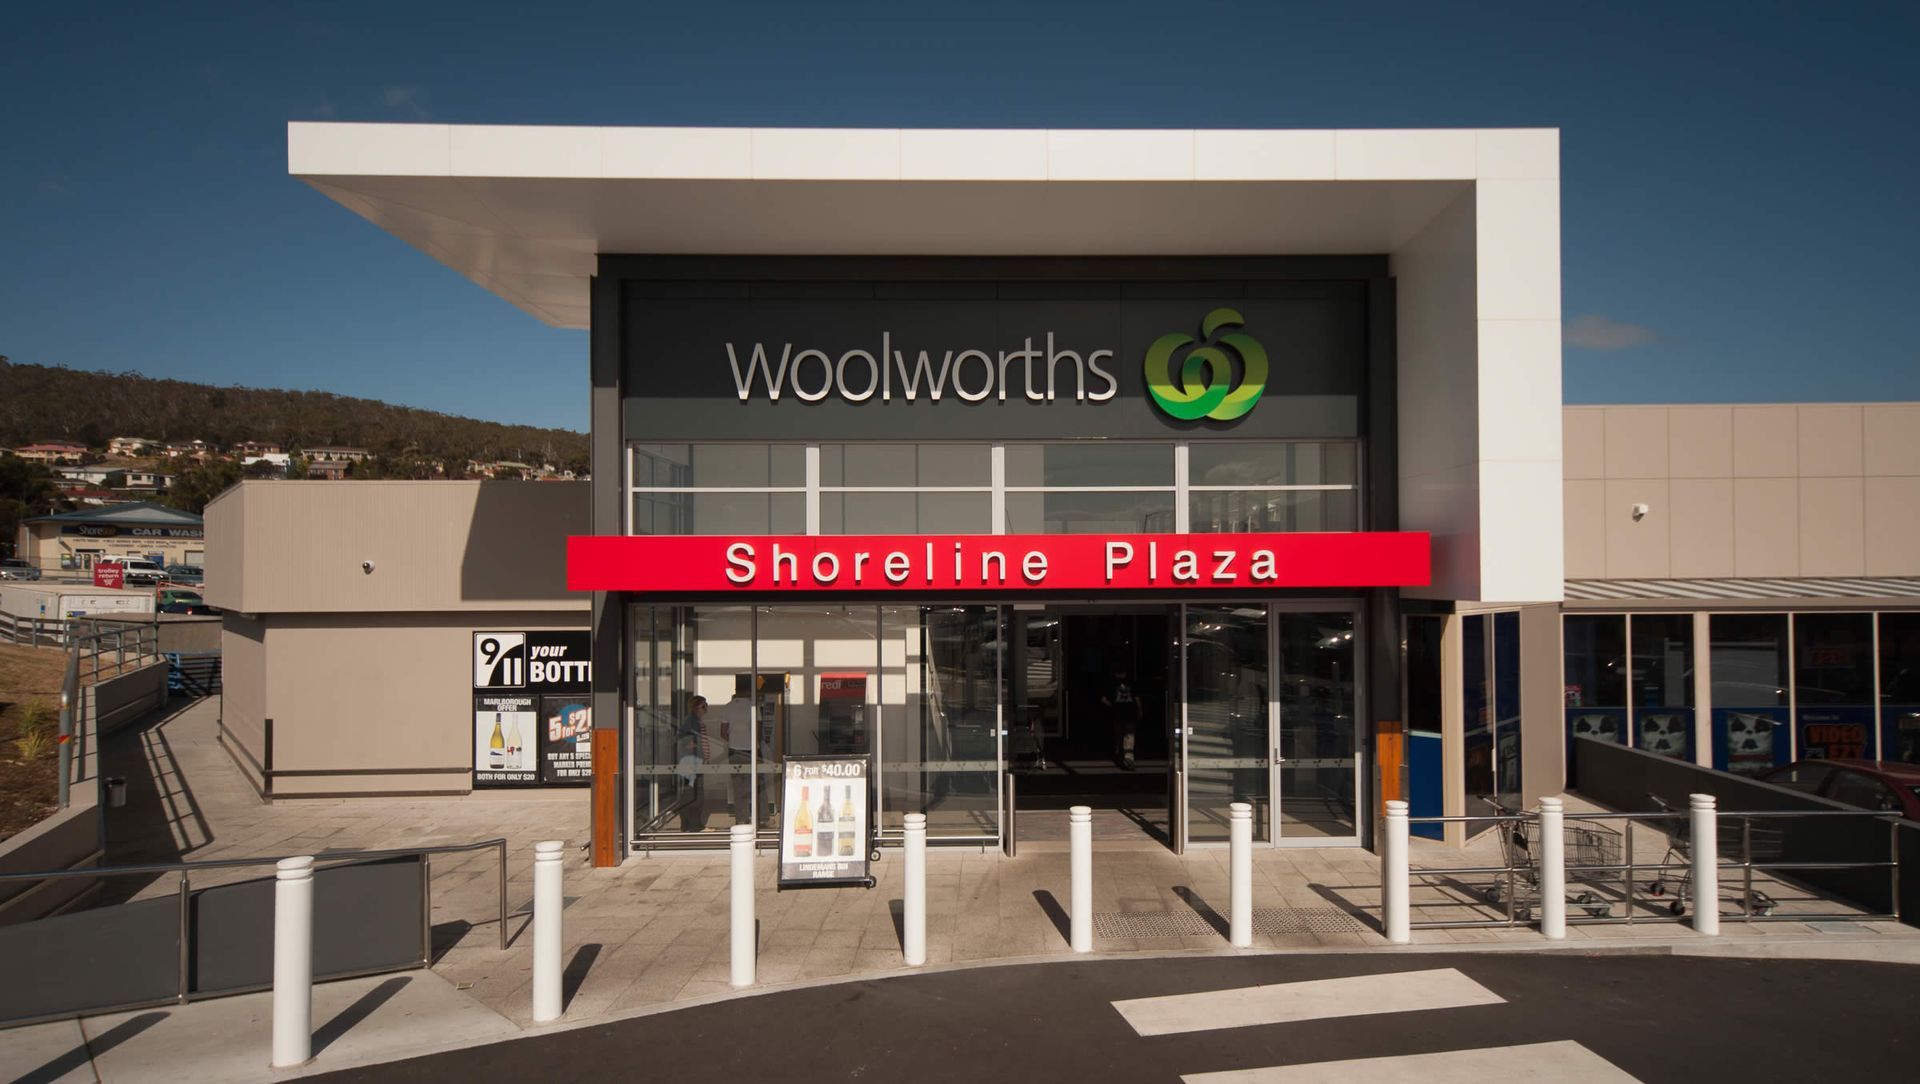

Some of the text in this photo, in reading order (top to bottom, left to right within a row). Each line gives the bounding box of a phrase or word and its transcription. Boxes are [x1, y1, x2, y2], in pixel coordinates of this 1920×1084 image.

[725, 331, 1118, 403] Woolworths
[132, 528, 162, 536] CAR
[725, 541, 1278, 584] Shoreline Plaza
[530, 645, 567, 659] your
[484, 698, 532, 706] MARLBOROUGH
[549, 717, 563, 742] 5
[562, 726, 576, 739] for
[1809, 725, 1864, 743] VIDEO
[793, 763, 861, 776] 6 FOR $40.00
[477, 773, 535, 781] BOTH FOR ONLY $20
